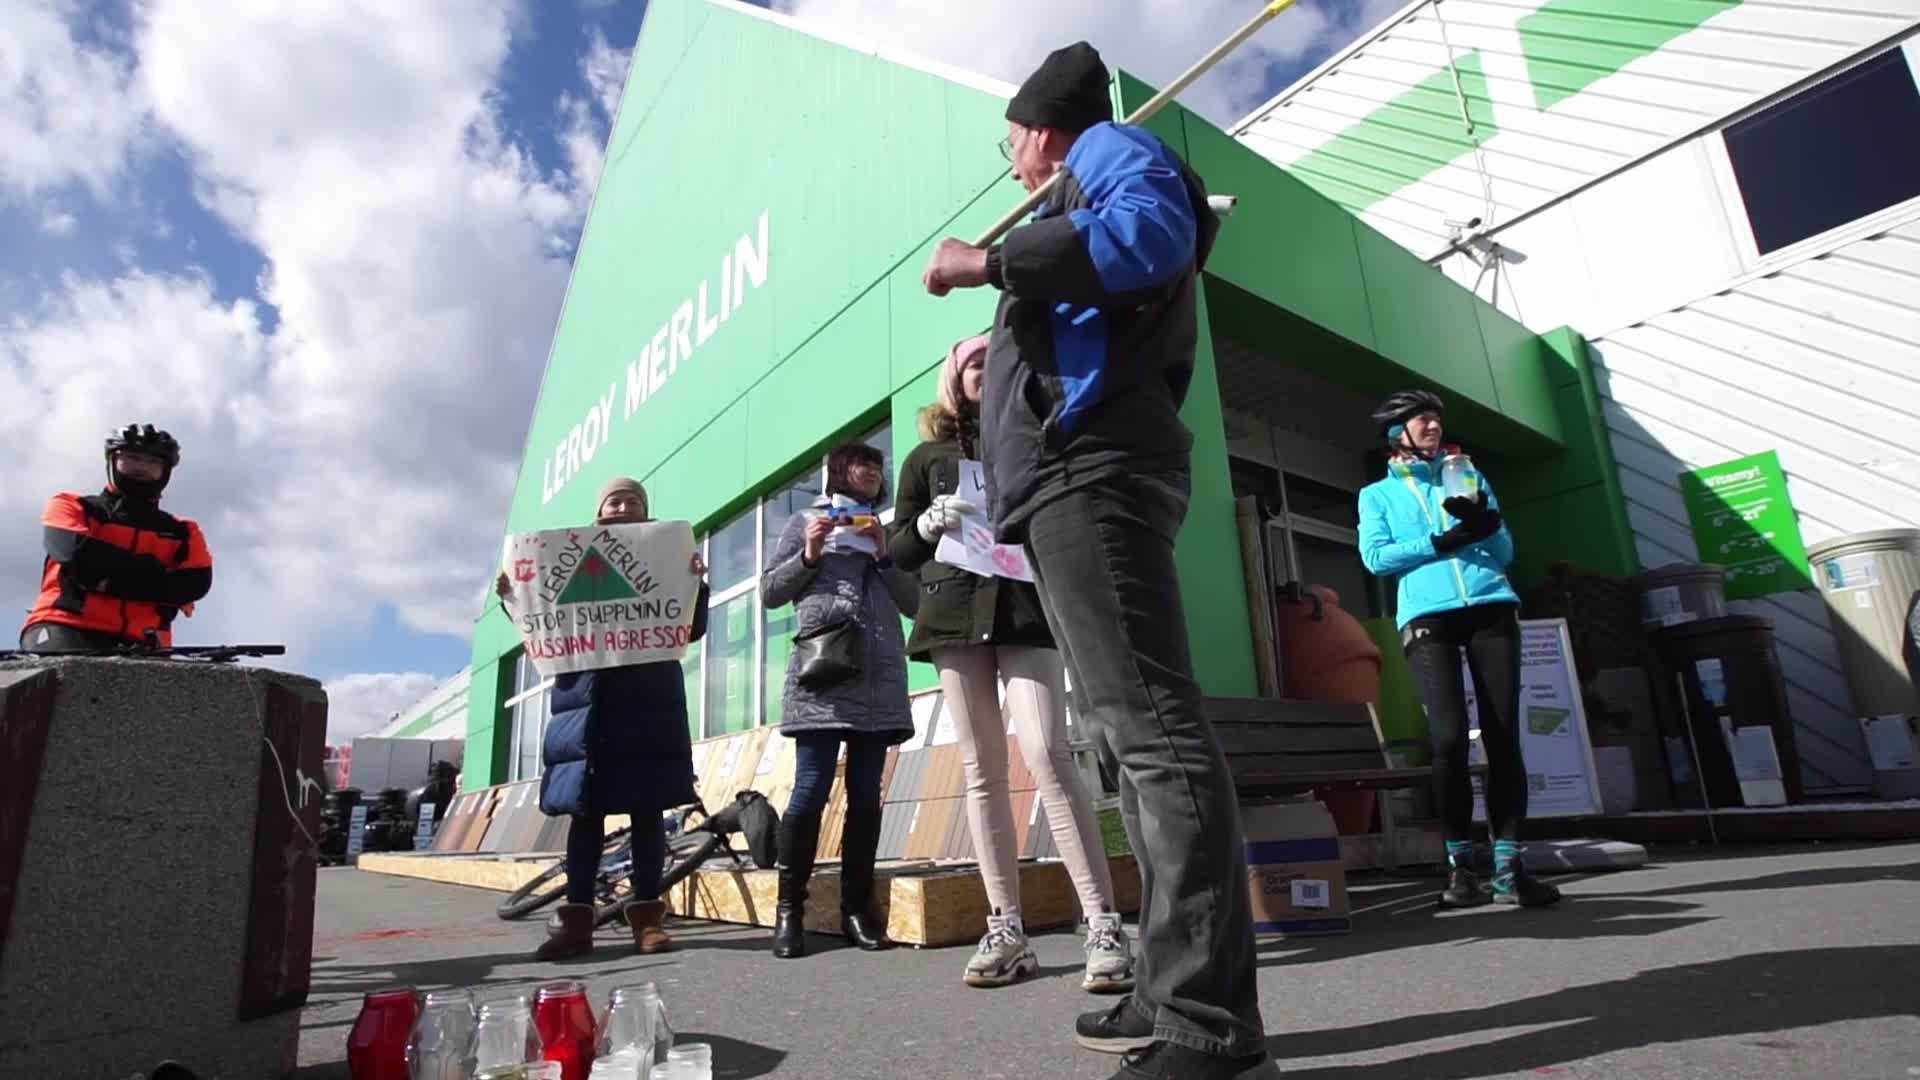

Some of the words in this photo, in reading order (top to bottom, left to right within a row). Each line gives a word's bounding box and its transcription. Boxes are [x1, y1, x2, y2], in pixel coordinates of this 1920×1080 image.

[542, 381, 616, 504] LEROY
[624, 208, 769, 421] MERLIN
[539, 538, 585, 603] LEROY
[592, 529, 660, 595] MERLIN
[523, 610, 566, 634] STOP
[576, 599, 682, 626] SUPPLYING
